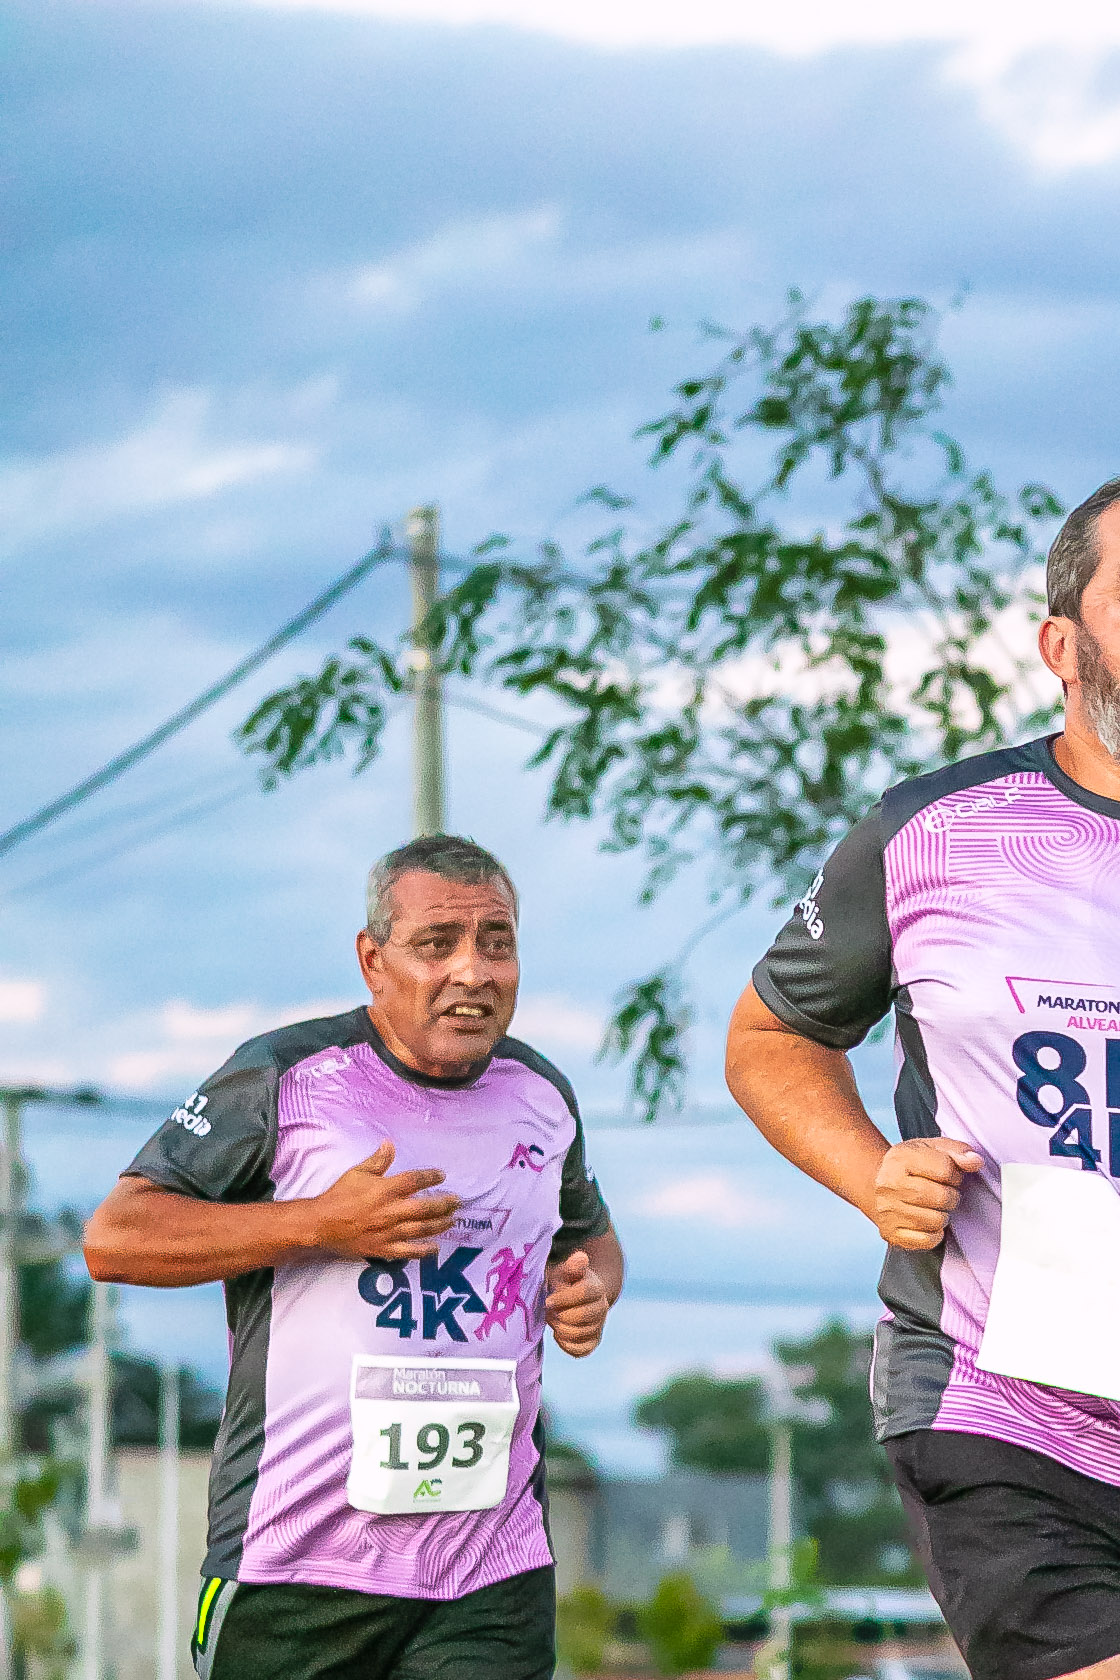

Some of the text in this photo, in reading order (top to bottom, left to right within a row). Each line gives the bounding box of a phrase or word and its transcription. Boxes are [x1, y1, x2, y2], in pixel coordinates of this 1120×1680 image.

[1037, 994, 1120, 1015] MARATON
[375, 1291, 469, 1343] 4K
[392, 1380, 481, 1396] NOCTURNA
[380, 1421, 486, 1471] 193
